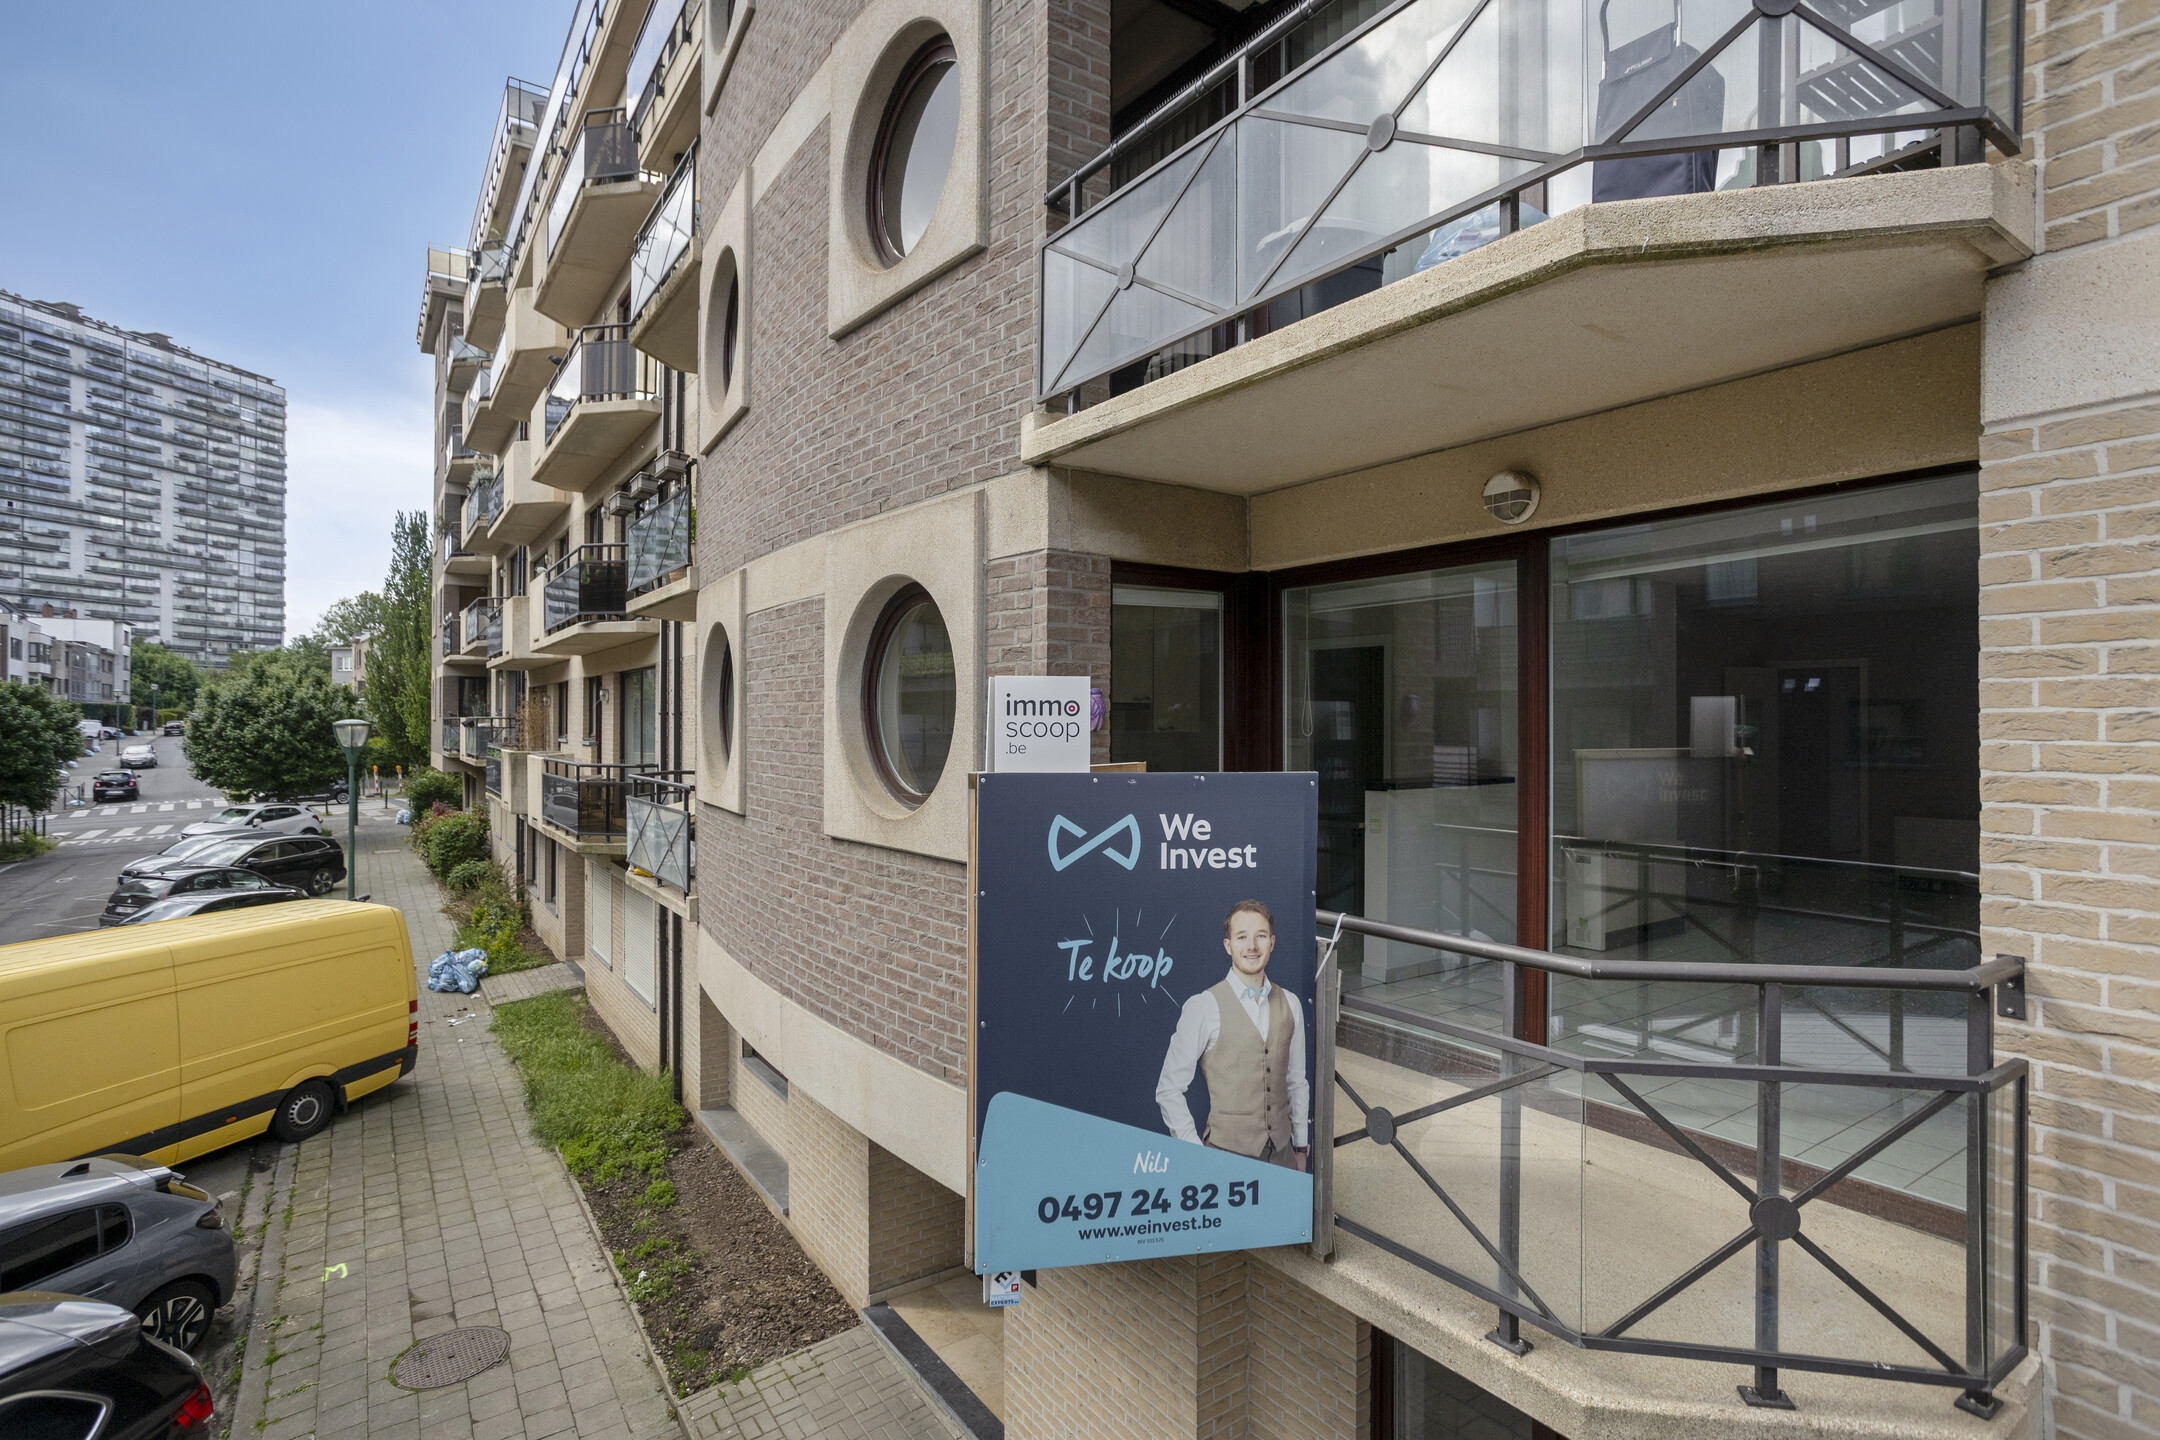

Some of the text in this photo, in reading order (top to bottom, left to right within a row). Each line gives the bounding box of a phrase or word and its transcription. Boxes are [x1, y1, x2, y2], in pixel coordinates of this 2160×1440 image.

[1006, 693, 1080, 717] immo
[1006, 721, 1080, 743] scoop
[1005, 742, 1027, 754] .be
[1159, 813, 1212, 841] We
[1160, 842, 1257, 870] Invest
[1057, 936, 1174, 989] Te koop
[1133, 1151, 1170, 1174] Nils
[1038, 1180, 1259, 1224] 0497 24 82 51
[1078, 1214, 1222, 1240] www.weinvest.be
